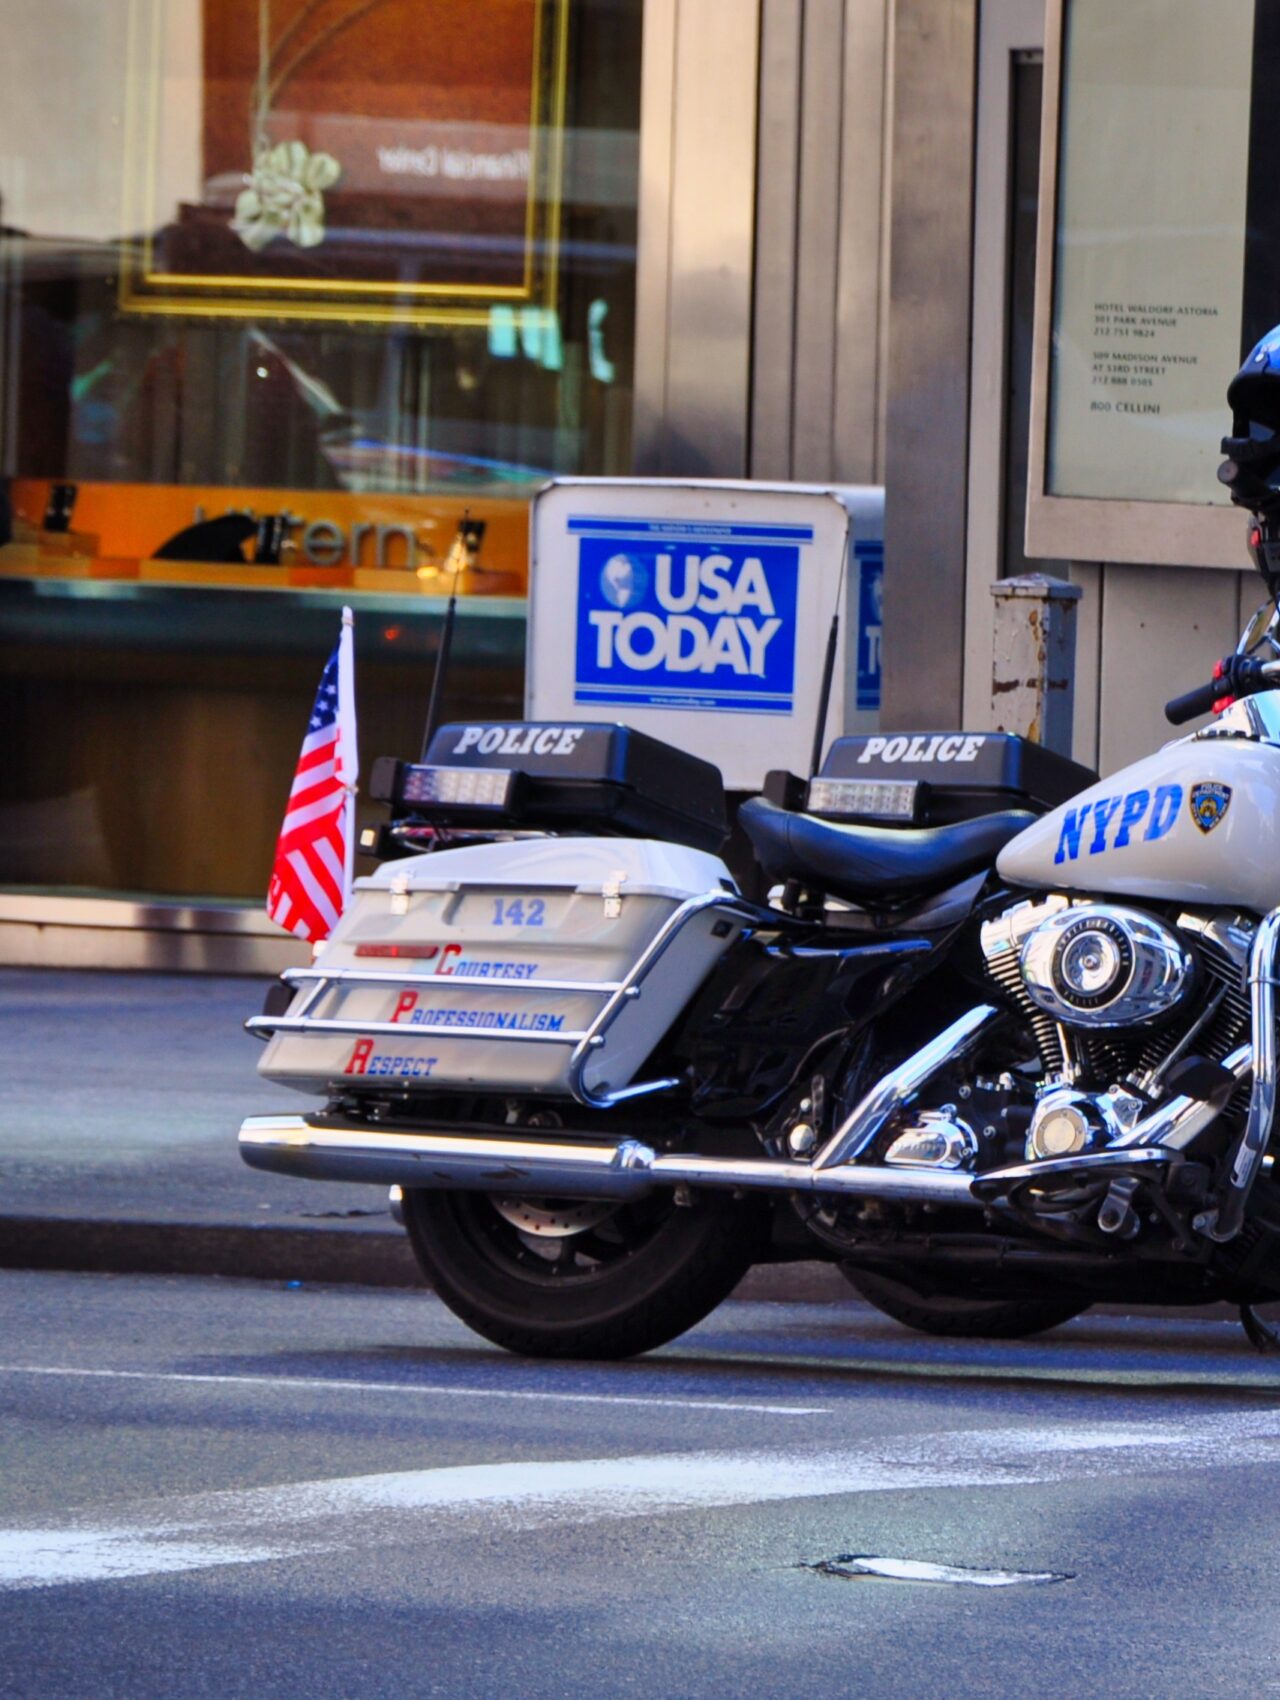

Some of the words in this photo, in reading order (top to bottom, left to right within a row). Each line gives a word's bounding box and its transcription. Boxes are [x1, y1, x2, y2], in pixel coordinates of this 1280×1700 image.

[1177, 306, 1219, 316] ASTORIA
[1112, 352, 1158, 363] MADISON
[1116, 402, 1161, 414] CELLINI
[654, 554, 776, 616] USA
[589, 610, 783, 677] TODAY
[452, 727, 584, 755] POLICE
[857, 736, 986, 764] POLICE
[1054, 784, 1183, 865] NYPD
[492, 899, 545, 926] 142
[390, 990, 565, 1032] PROFESSIONALISM
[344, 1038, 438, 1077] RESPECT
